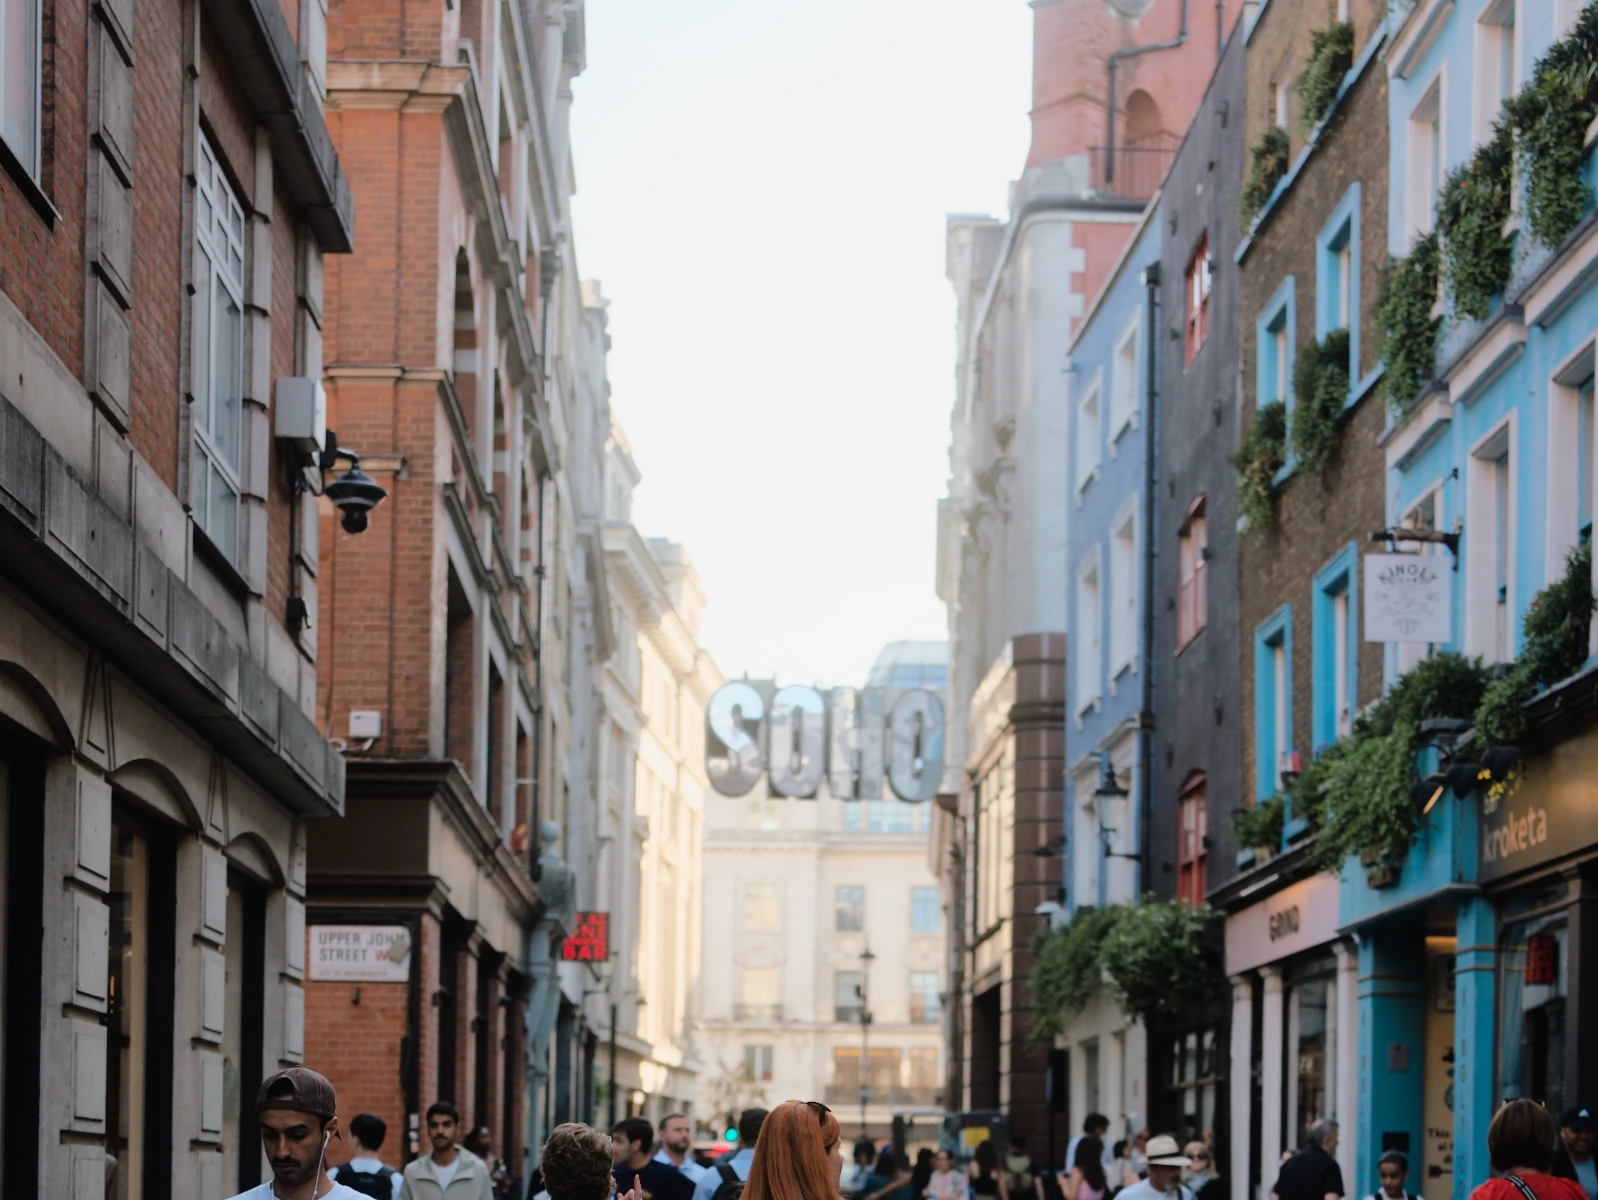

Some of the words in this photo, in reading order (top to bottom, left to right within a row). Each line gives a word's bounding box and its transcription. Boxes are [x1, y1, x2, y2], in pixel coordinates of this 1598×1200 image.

[1377, 564, 1438, 587] KINGLY
[706, 682, 944, 804] SOHO
[1483, 804, 1547, 864] kroketa
[318, 932, 361, 946] UPPER
[318, 949, 368, 963] STREET
[562, 944, 607, 962] BAR
